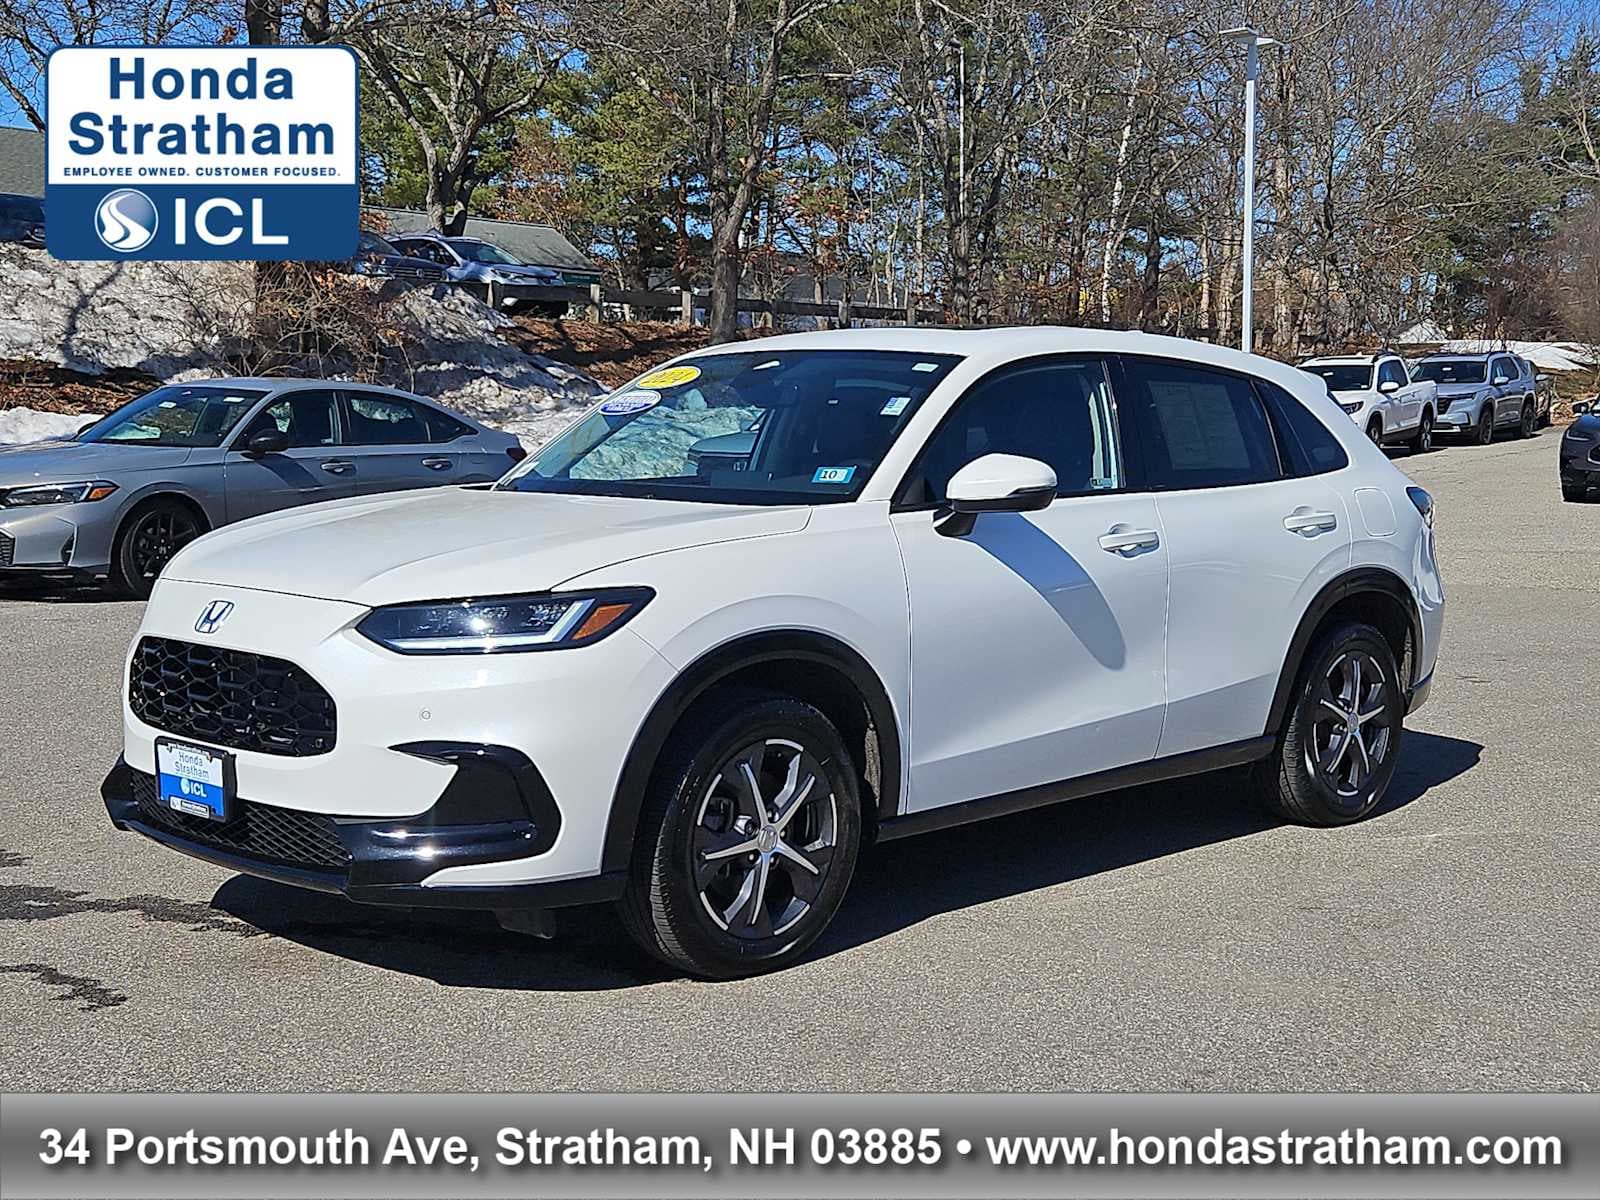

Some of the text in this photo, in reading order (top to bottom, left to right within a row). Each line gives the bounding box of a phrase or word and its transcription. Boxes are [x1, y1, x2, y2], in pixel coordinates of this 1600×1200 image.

[821, 469, 838, 480] 10
[178, 752, 203, 767] Honda
[175, 761, 209, 778] Stratham
[190, 781, 208, 798] ICL
